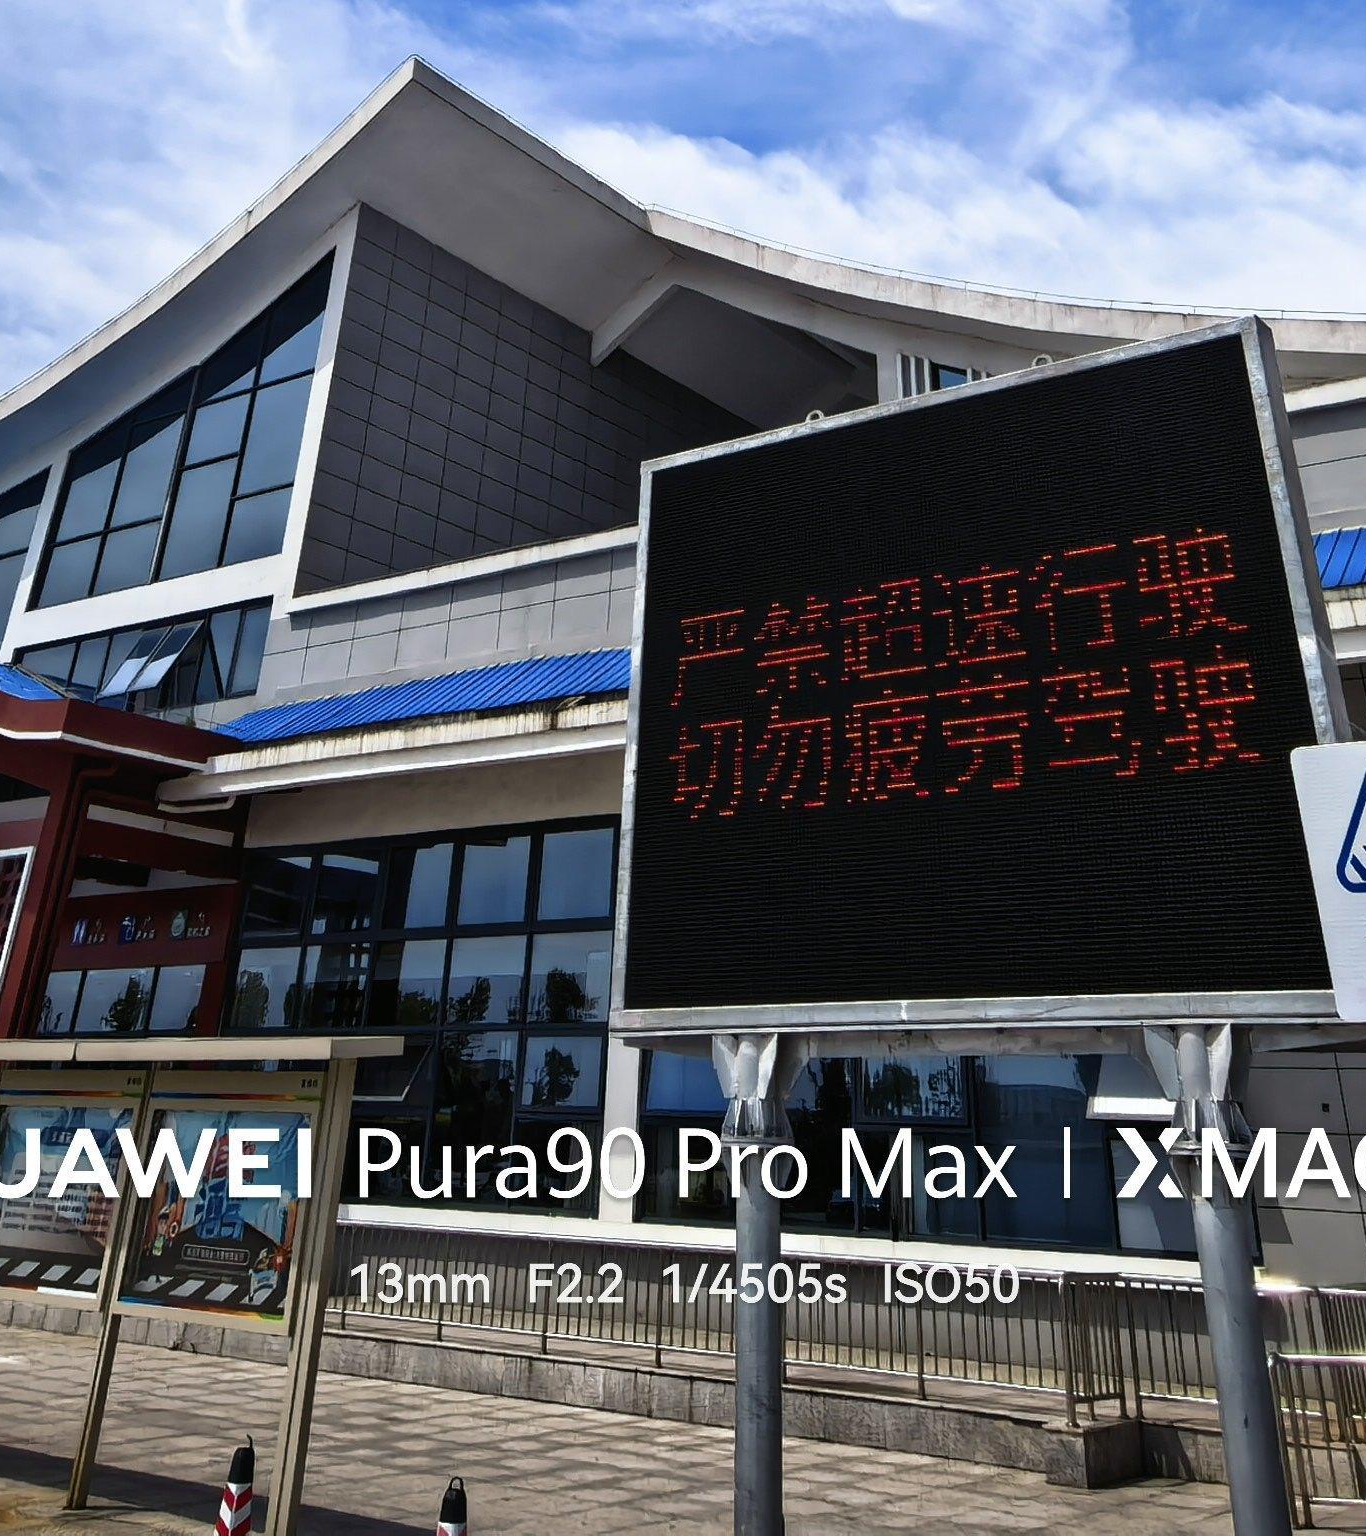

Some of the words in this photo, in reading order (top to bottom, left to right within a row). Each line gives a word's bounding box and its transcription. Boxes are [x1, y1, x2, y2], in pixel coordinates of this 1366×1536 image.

[670, 527, 1248, 707] 严禁超速行驶
[668, 645, 1262, 818] 切勿疲劳驾驶
